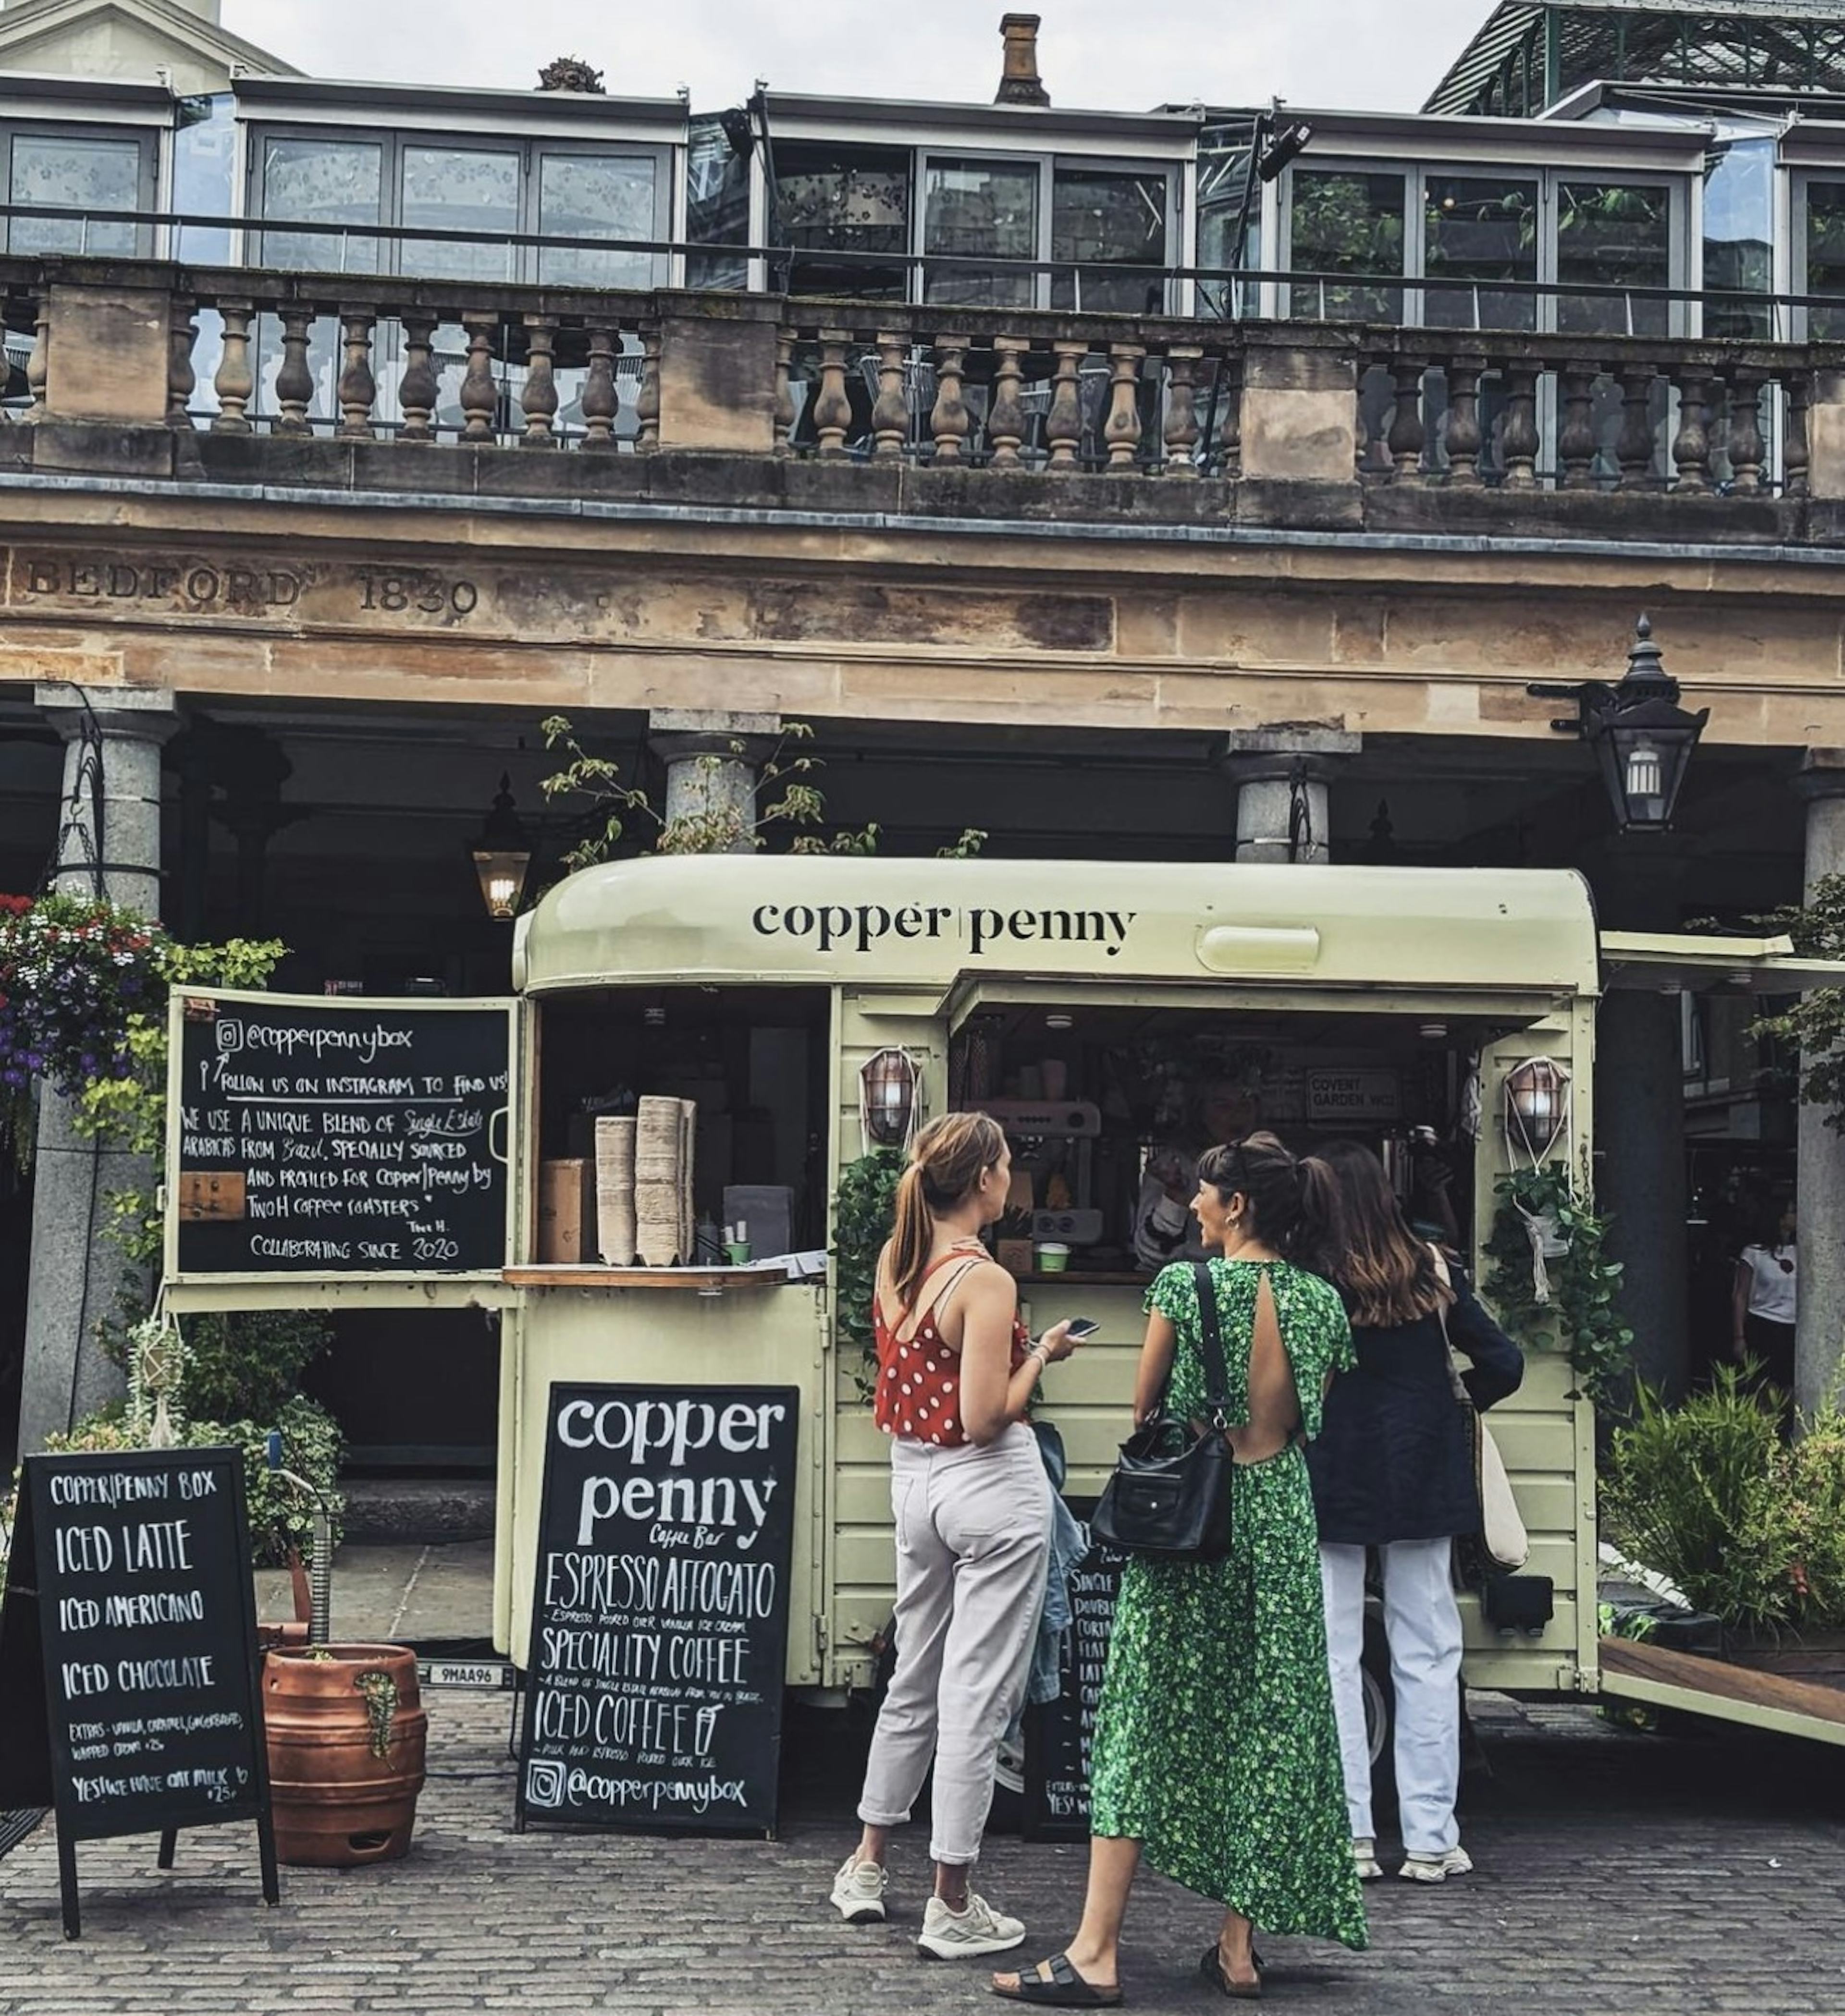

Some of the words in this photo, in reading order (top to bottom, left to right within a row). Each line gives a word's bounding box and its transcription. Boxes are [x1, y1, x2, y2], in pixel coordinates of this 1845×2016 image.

[25, 561, 300, 606] BEDFORD
[358, 575, 479, 614] 1830
[247, 1024, 413, 1063] @copperpennybox
[272, 1077, 288, 1094] US
[295, 1078, 319, 1094] ON
[326, 1076, 414, 1096] INSTAGRAM
[422, 1076, 443, 1094] TO
[454, 1075, 485, 1096] FIND
[1312, 1076, 1361, 1091] COVENT
[180, 1107, 199, 1130] WE
[207, 1109, 232, 1132] USE
[241, 1108, 252, 1133] A
[256, 1110, 313, 1134] UNIQUE
[323, 1112, 371, 1134] BLEND
[376, 1114, 394, 1133] OF
[183, 1135, 235, 1158] ARABICAS
[241, 1137, 274, 1160] FROM
[331, 1139, 405, 1161] SPECIALLY
[410, 1142, 467, 1161] SOURCED
[246, 1167, 275, 1187] AND
[342, 1168, 369, 1188] FOR
[472, 1161, 492, 1190] by
[357, 1241, 402, 1260] SINCE
[412, 1236, 459, 1260] 2020
[557, 1399, 786, 1466] copper
[179, 1470, 218, 1501] BOX
[577, 1476, 777, 1549] penny
[55, 1525, 113, 1574] ICED
[122, 1519, 194, 1573] LATTE
[693, 1525, 725, 1549] Bar
[544, 1552, 659, 1614] ESPRESSO
[662, 1557, 775, 1618] AFFOGATO
[59, 1597, 99, 1632] ICED
[105, 1590, 204, 1628] AMERICANO
[541, 1627, 661, 1680] SPECIALITY
[669, 1636, 750, 1684] COFFEE
[62, 1661, 110, 1700] ICED
[118, 1655, 215, 1692] CHOCOLATE
[534, 1689, 591, 1741] ICED
[595, 1694, 691, 1754] COFFEE
[193, 1767, 228, 1787] MILK
[567, 1767, 748, 1813] @copperpennybox
